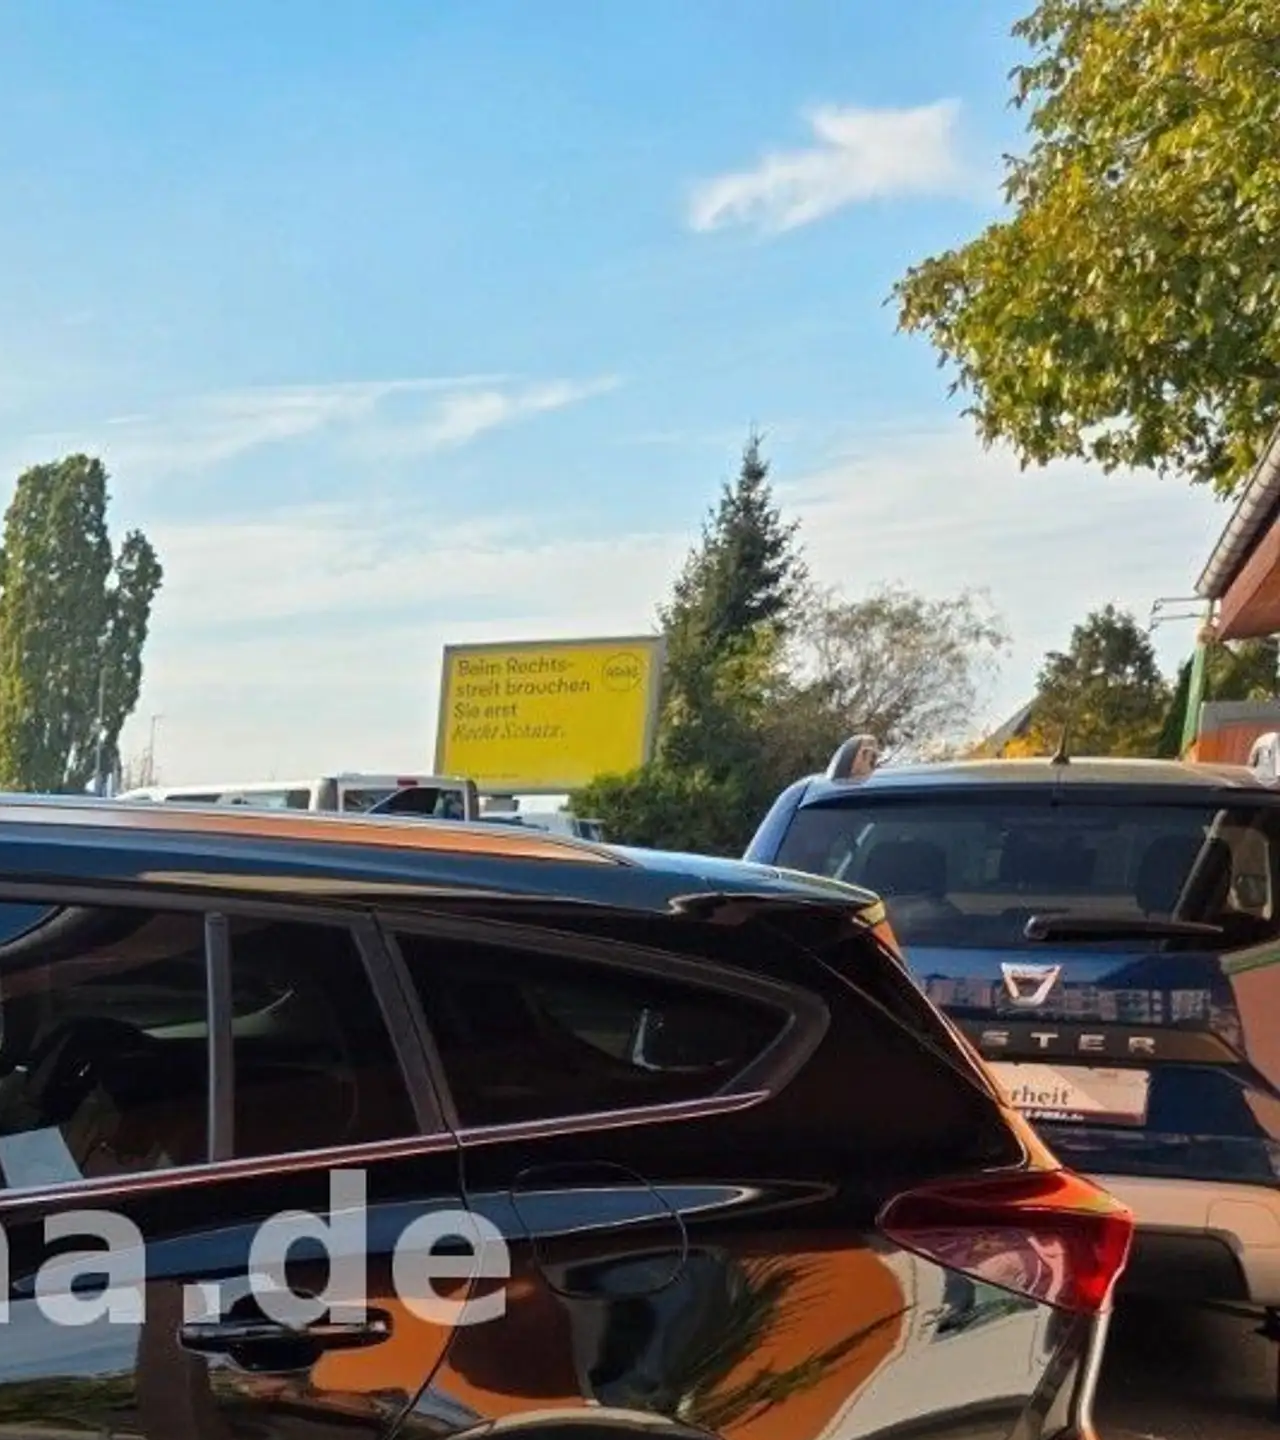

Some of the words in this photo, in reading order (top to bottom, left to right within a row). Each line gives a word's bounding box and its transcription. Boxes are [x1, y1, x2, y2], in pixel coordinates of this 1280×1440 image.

[458, 660, 501, 677] Beim
[506, 656, 575, 674] Rechts-
[456, 681, 500, 699] streit
[506, 679, 591, 697] brauchen
[453, 703, 480, 720] Sie
[484, 703, 517, 719] erst
